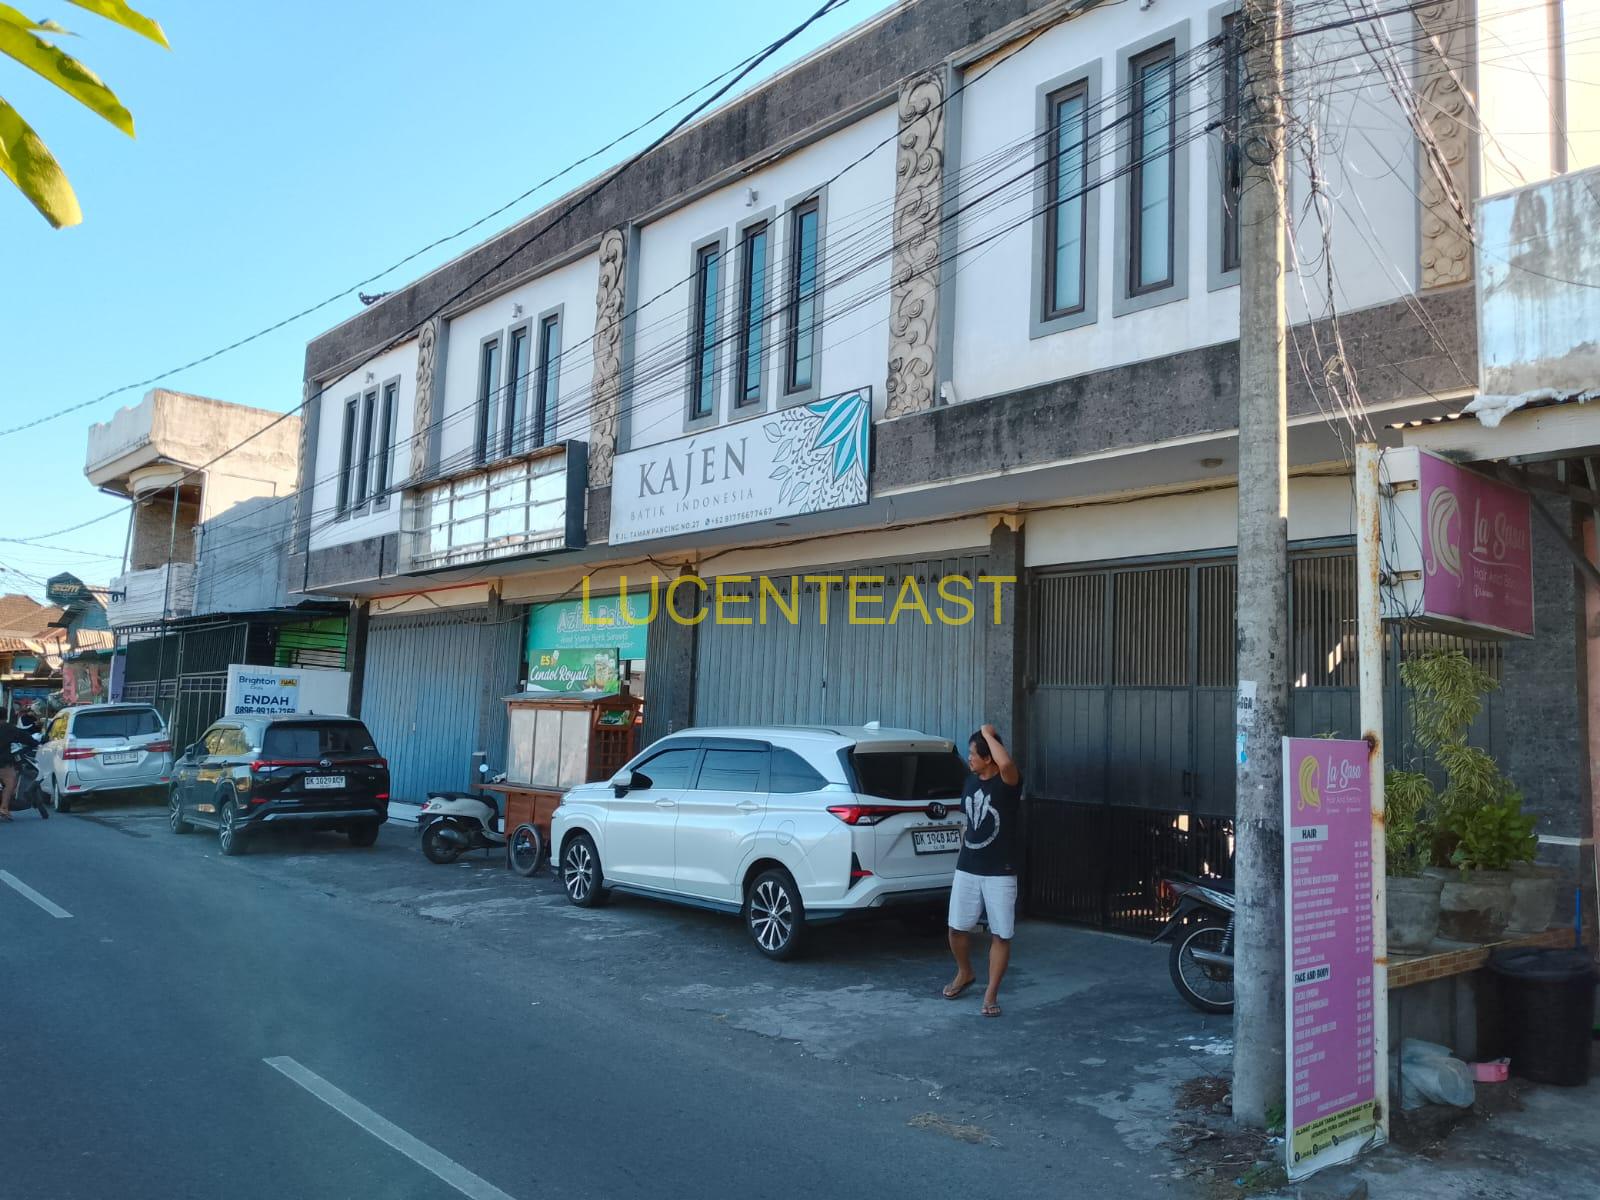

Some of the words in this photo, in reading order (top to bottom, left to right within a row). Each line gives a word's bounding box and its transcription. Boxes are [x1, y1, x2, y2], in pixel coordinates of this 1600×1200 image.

[638, 438, 749, 500] KAJEN
[630, 506, 666, 521] BATIK
[676, 488, 754, 513] INDONESIA
[239, 675, 276, 686] Brighton
[530, 665, 559, 681] Cendol
[244, 695, 289, 706] ENDAH
[915, 834, 925, 846] DK
[927, 832, 945, 845] 1948
[1302, 828, 1317, 839] HAIR
[1295, 973, 1306, 985] FACE
[1307, 969, 1316, 980] AND
[1317, 967, 1329, 978] BODY
